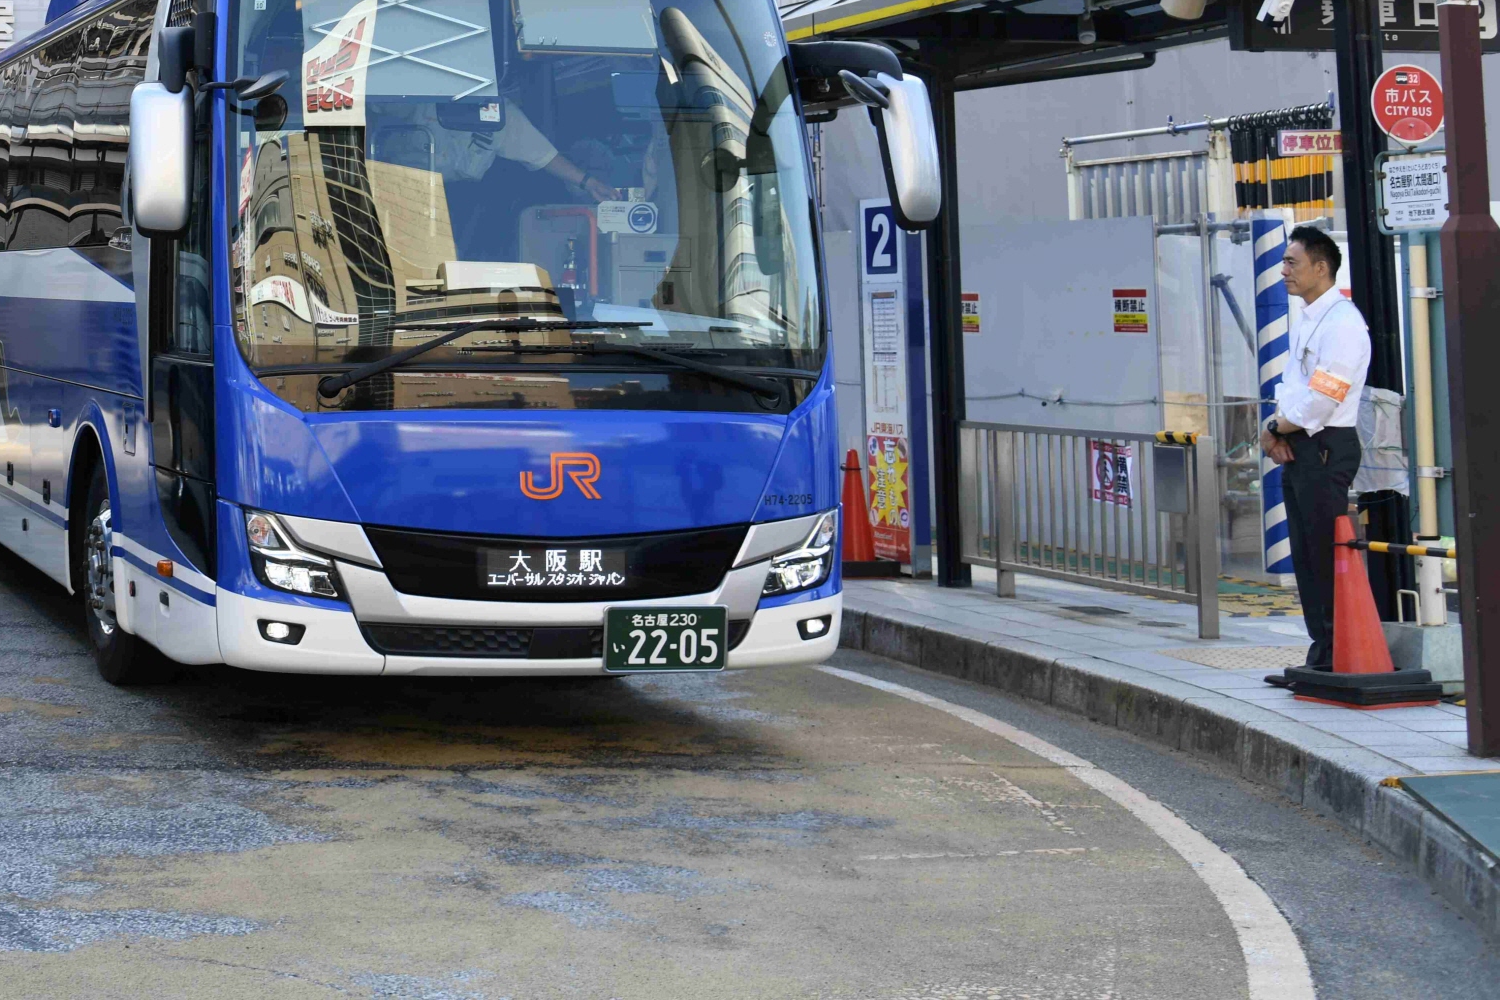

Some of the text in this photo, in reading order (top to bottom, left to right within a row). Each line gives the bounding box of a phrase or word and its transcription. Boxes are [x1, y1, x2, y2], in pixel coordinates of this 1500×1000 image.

[1408, 74, 1419, 84] 32
[1384, 88, 1432, 104] 市バス
[1385, 105, 1432, 117] CITY BUS
[871, 213, 892, 268] 2
[520, 452, 601, 500] JR
[764, 494, 813, 506] H74-2205
[509, 550, 603, 572] 大阪駅
[612, 628, 719, 665] い 22-05
